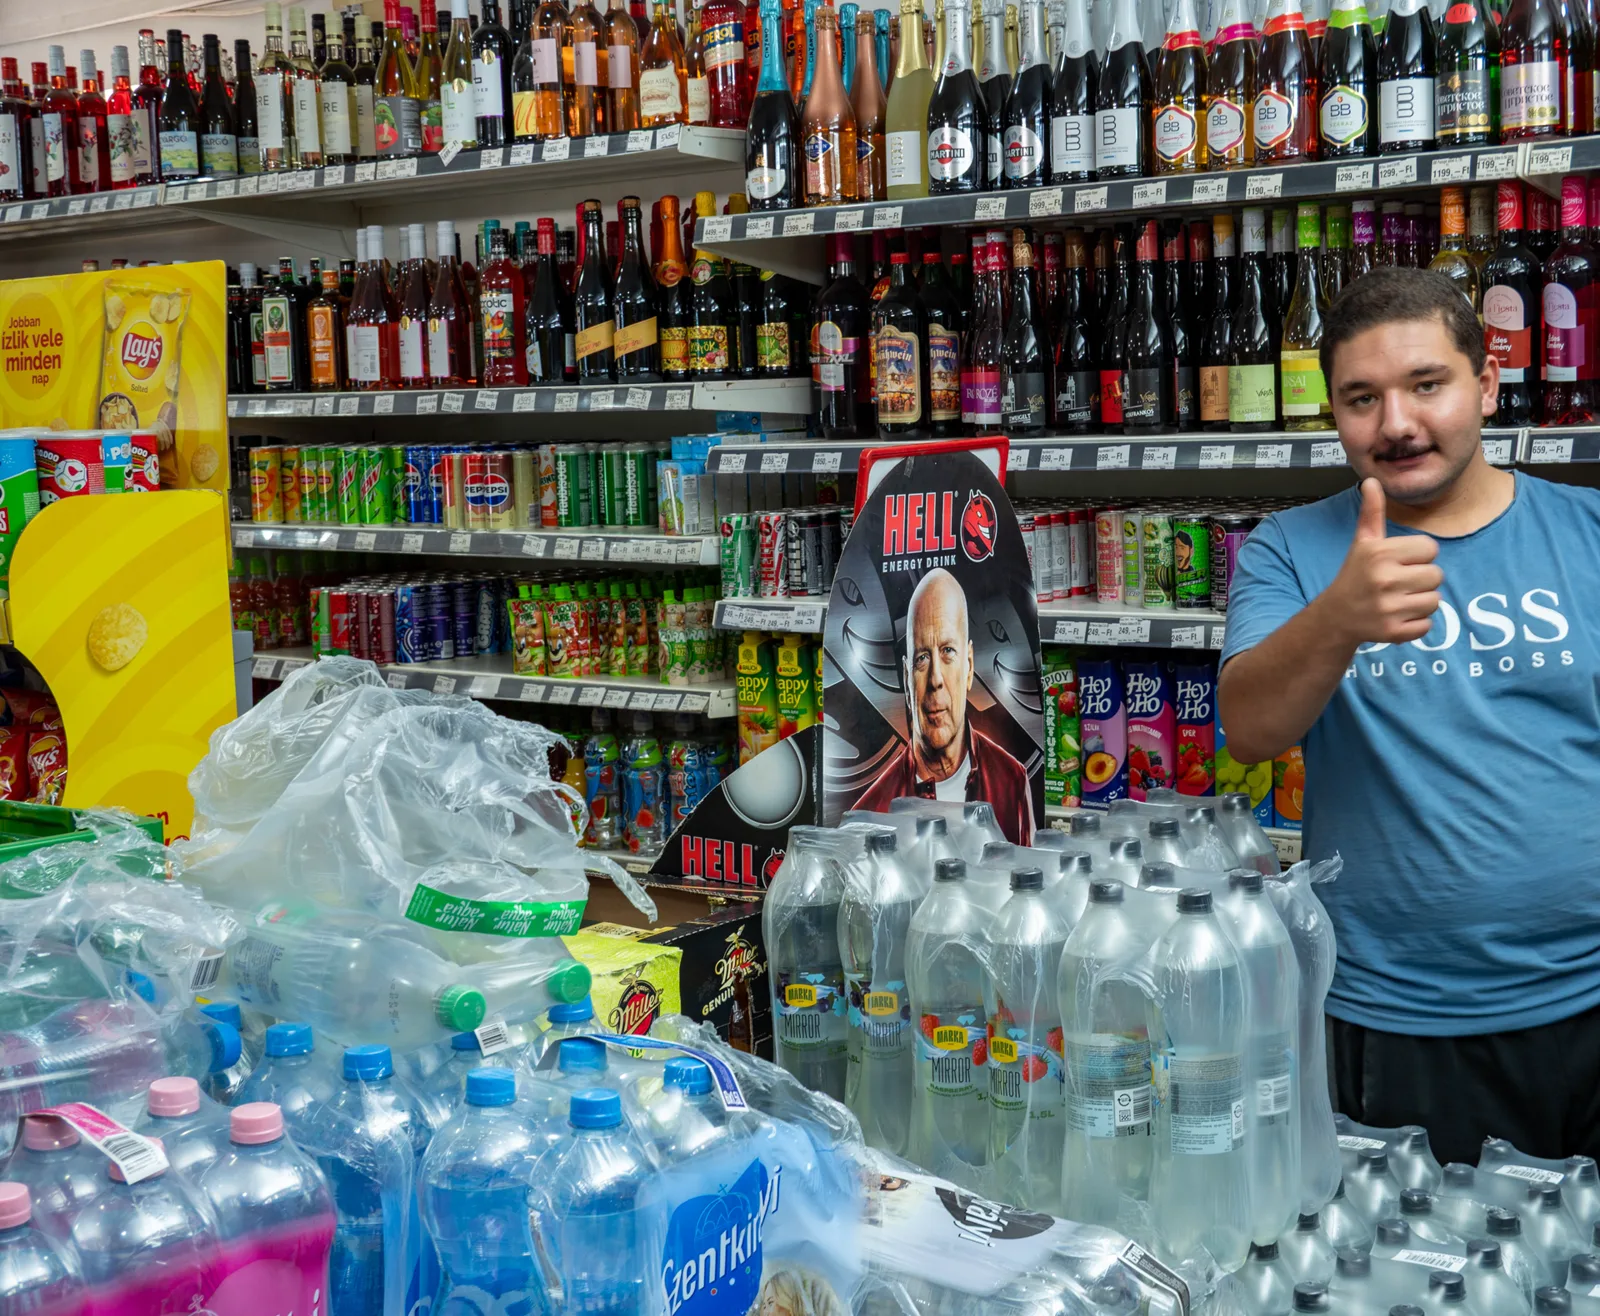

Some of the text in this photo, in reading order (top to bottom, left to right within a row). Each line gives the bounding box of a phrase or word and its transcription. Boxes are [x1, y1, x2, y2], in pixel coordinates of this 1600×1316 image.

[1212, 115, 1228, 126] BB
[1259, 108, 1277, 120] BB
[1330, 104, 1351, 117] BB
[1163, 122, 1180, 133] BB
[930, 148, 965, 159] MARTINI
[8, 315, 41, 329] Jobban
[1, 330, 63, 351] ízlik vele
[123, 333, 160, 367] Lay's
[5, 350, 61, 372] minden
[31, 374, 49, 388] nap
[465, 485, 483, 494] PEP
[557, 458, 569, 517] Traubisoda
[625, 458, 637, 517] Traubisoda
[883, 490, 957, 556] HELL
[882, 554, 957, 573] ENERGY DRINK
[1352, 588, 1569, 655] OSS
[742, 664, 758, 672] RAUCH
[781, 666, 799, 674] RAUCH
[1344, 649, 1574, 678] HUGO BOSS
[1079, 675, 1112, 697] Hey
[1128, 672, 1162, 694] Hey
[1177, 680, 1210, 701] Hey
[738, 690, 762, 706] day
[778, 693, 802, 708] day
[1182, 728, 1197, 738] EPER
[681, 834, 758, 887] HELL
[715, 944, 759, 984] Miller
[608, 986, 664, 1035] Miller
[701, 986, 735, 1017] GENUIN
[784, 1012, 821, 1039] MIRROR
[863, 1021, 902, 1048] MIRROR
[931, 1056, 971, 1084] MIRROR
[989, 1067, 1021, 1099] MIRROR
